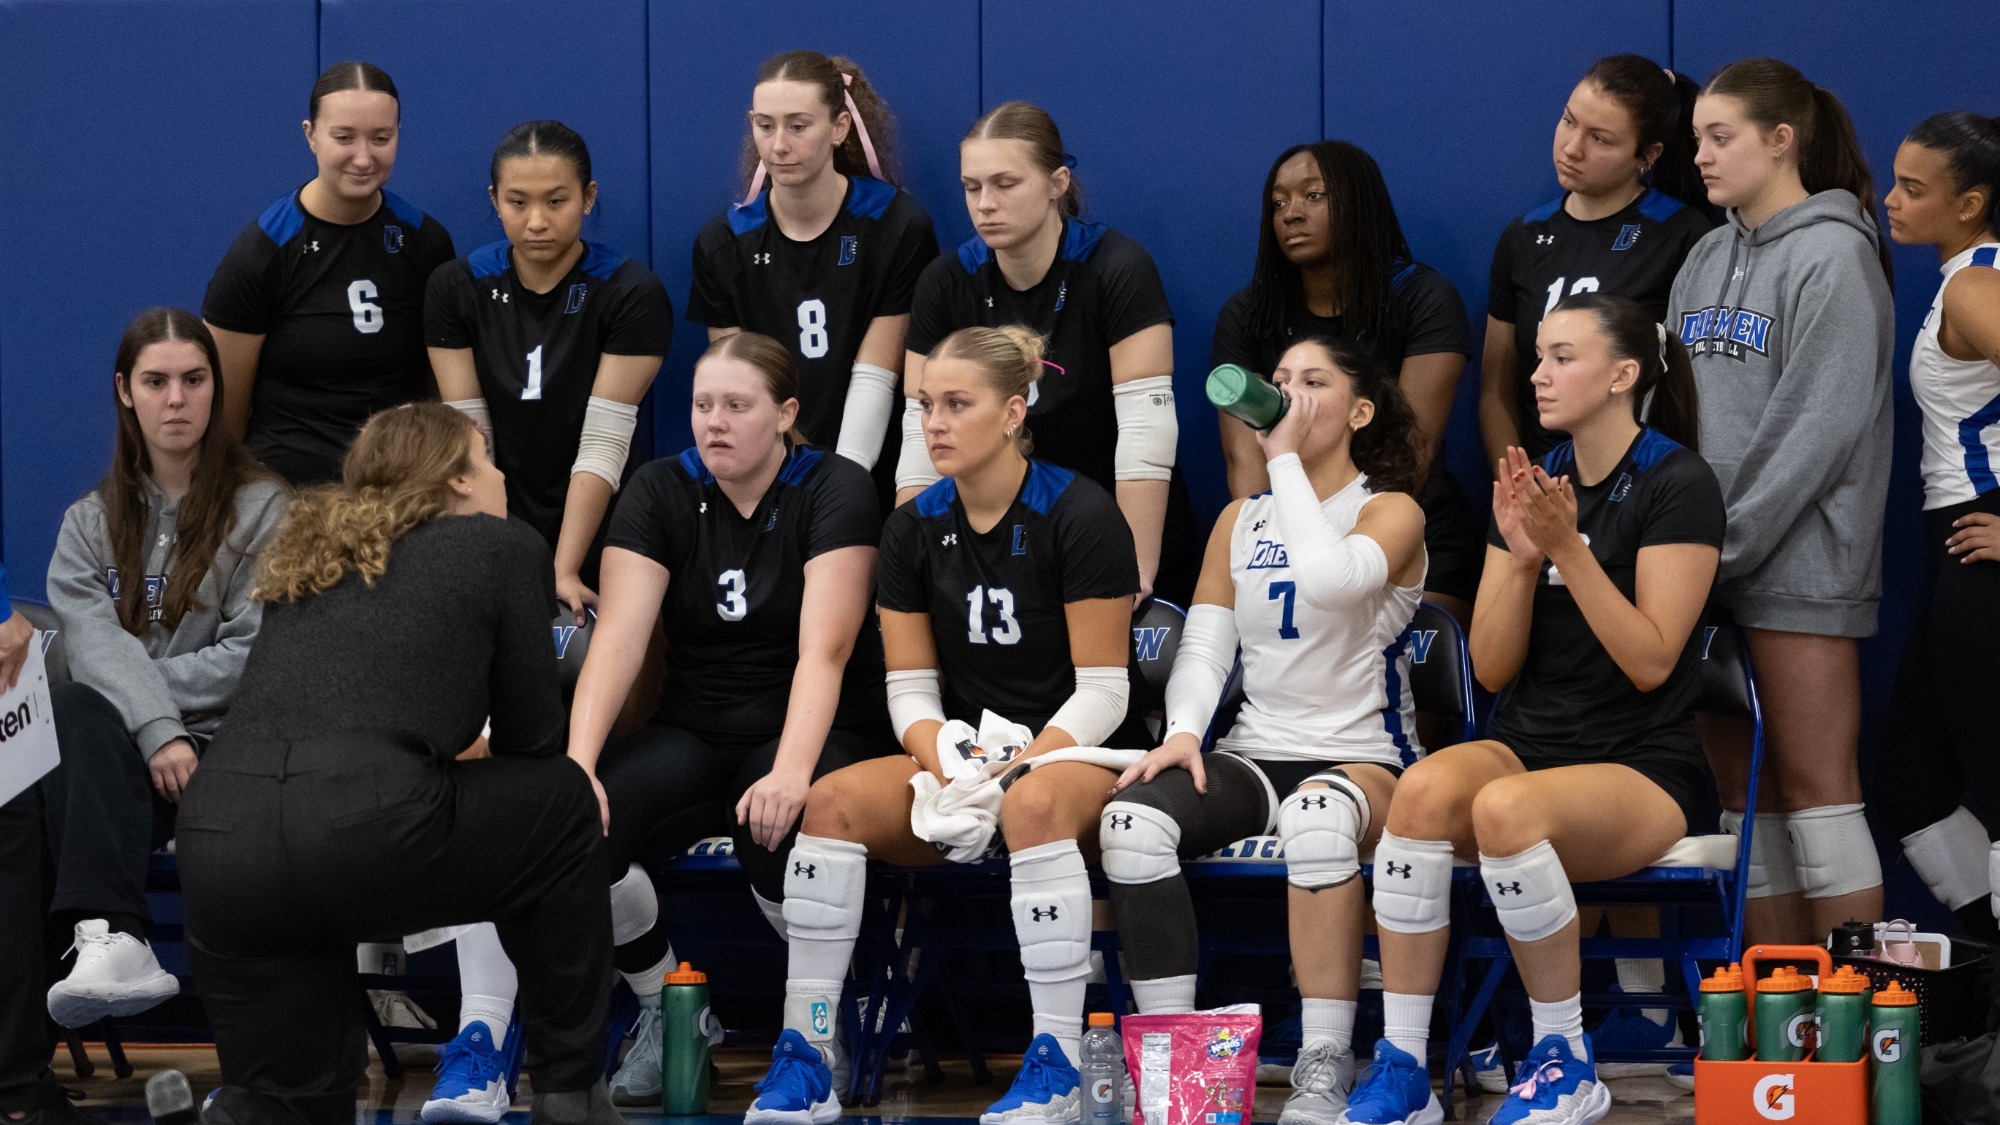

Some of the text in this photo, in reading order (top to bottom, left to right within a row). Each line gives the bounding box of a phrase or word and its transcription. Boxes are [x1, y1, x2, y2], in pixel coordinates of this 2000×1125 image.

[347, 279, 384, 334] 6
[797, 299, 829, 359] 8
[521, 344, 543, 400] 1
[716, 568, 747, 622] 3
[966, 584, 1022, 645] 13
[1268, 581, 1300, 640] 7
[1873, 1028, 1901, 1063] G
[1092, 1078, 1113, 1104] G
[1753, 1073, 1796, 1121] G
